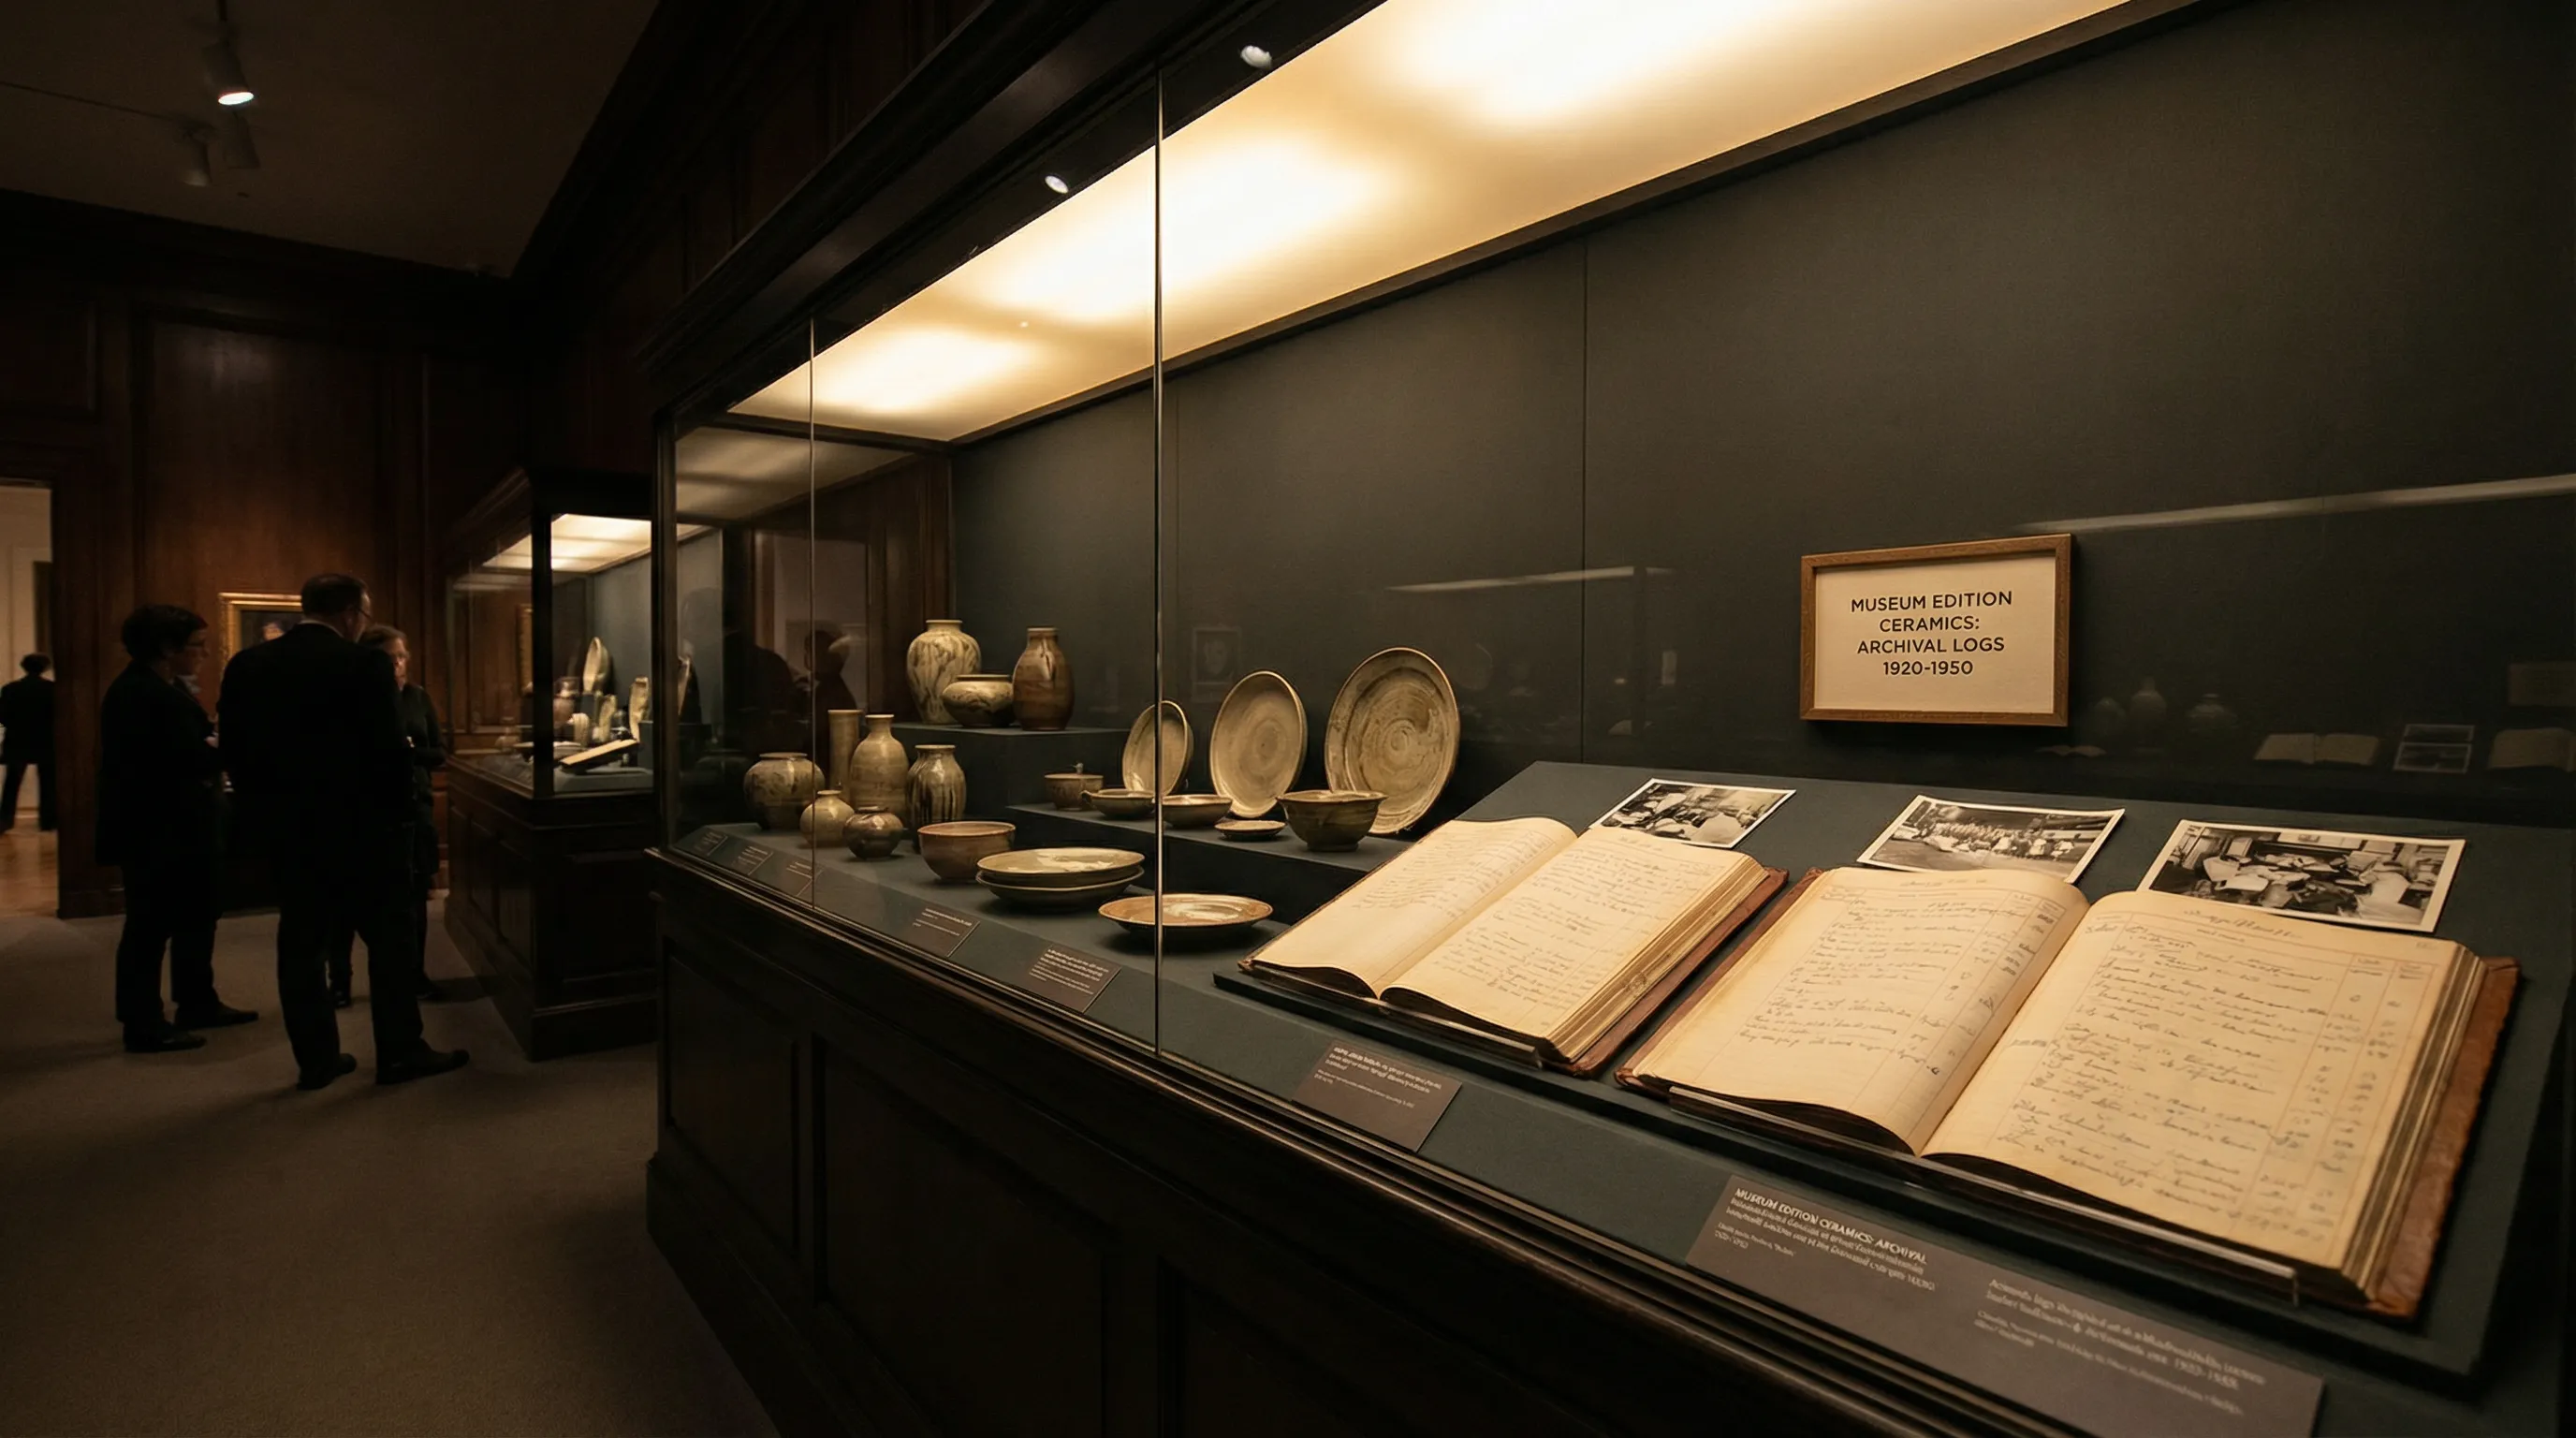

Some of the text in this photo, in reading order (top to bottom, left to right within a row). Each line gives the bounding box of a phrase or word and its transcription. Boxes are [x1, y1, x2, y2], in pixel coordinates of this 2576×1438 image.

[1851, 591, 2012, 612] MUSEUM EDITION
[1879, 615, 1980, 632] CERAMICS:
[1857, 637, 2005, 654] ARCHIVAL LOGS
[1882, 660, 1973, 676] 1920-1950
